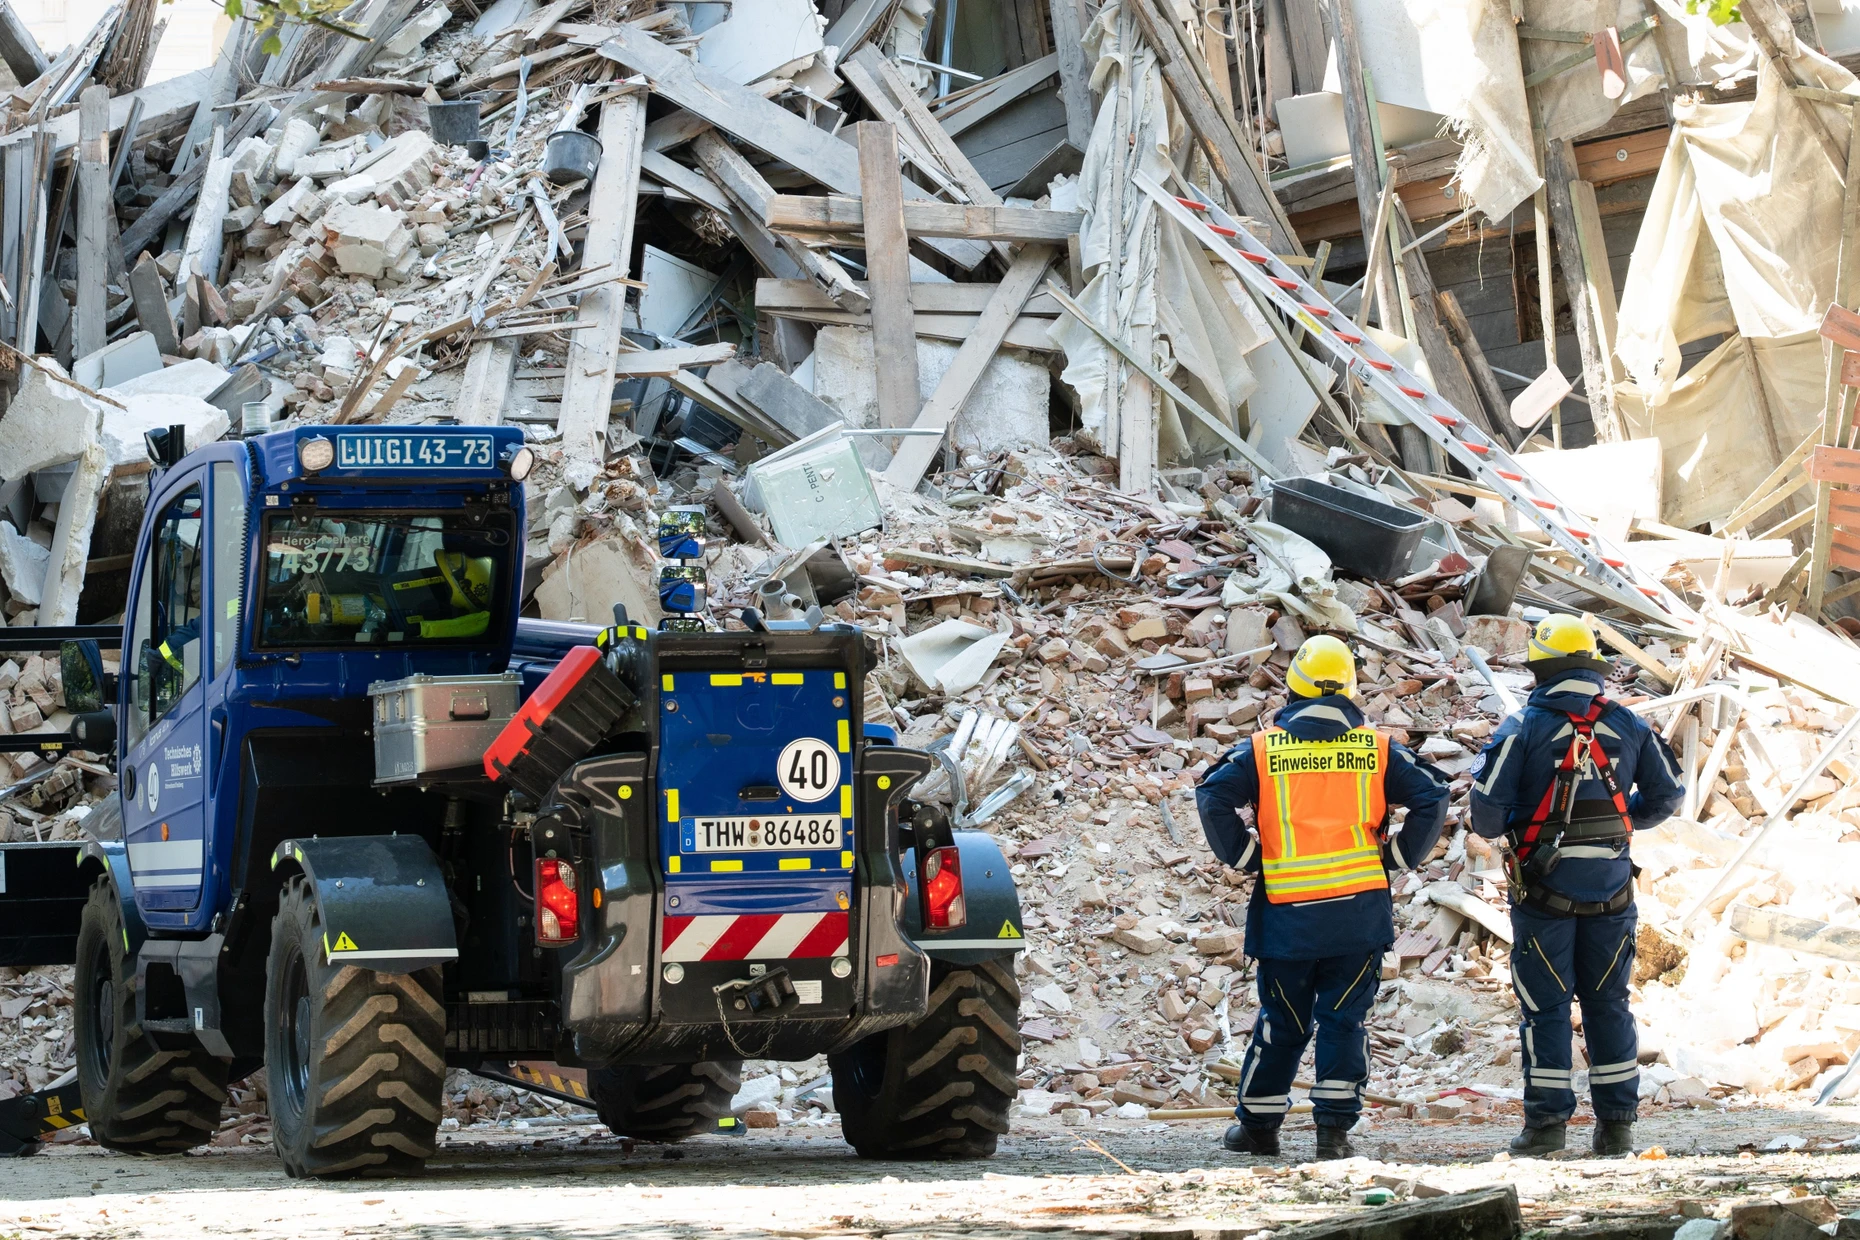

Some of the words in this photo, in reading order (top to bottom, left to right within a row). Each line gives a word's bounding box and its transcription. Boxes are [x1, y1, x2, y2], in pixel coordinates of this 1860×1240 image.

[341, 439, 414, 464] LUIGI
[418, 439, 491, 464] 43-73
[281, 536, 317, 546] Heros
[281, 547, 370, 574] 43/73
[164, 745, 192, 760] Technisches
[1269, 752, 1333, 773] Einweiser
[1336, 752, 1376, 771] BRmG
[789, 750, 828, 790] 40
[148, 771, 158, 802] 40
[685, 839, 692, 847] D
[701, 821, 744, 847] THW
[764, 820, 835, 846] 86486
